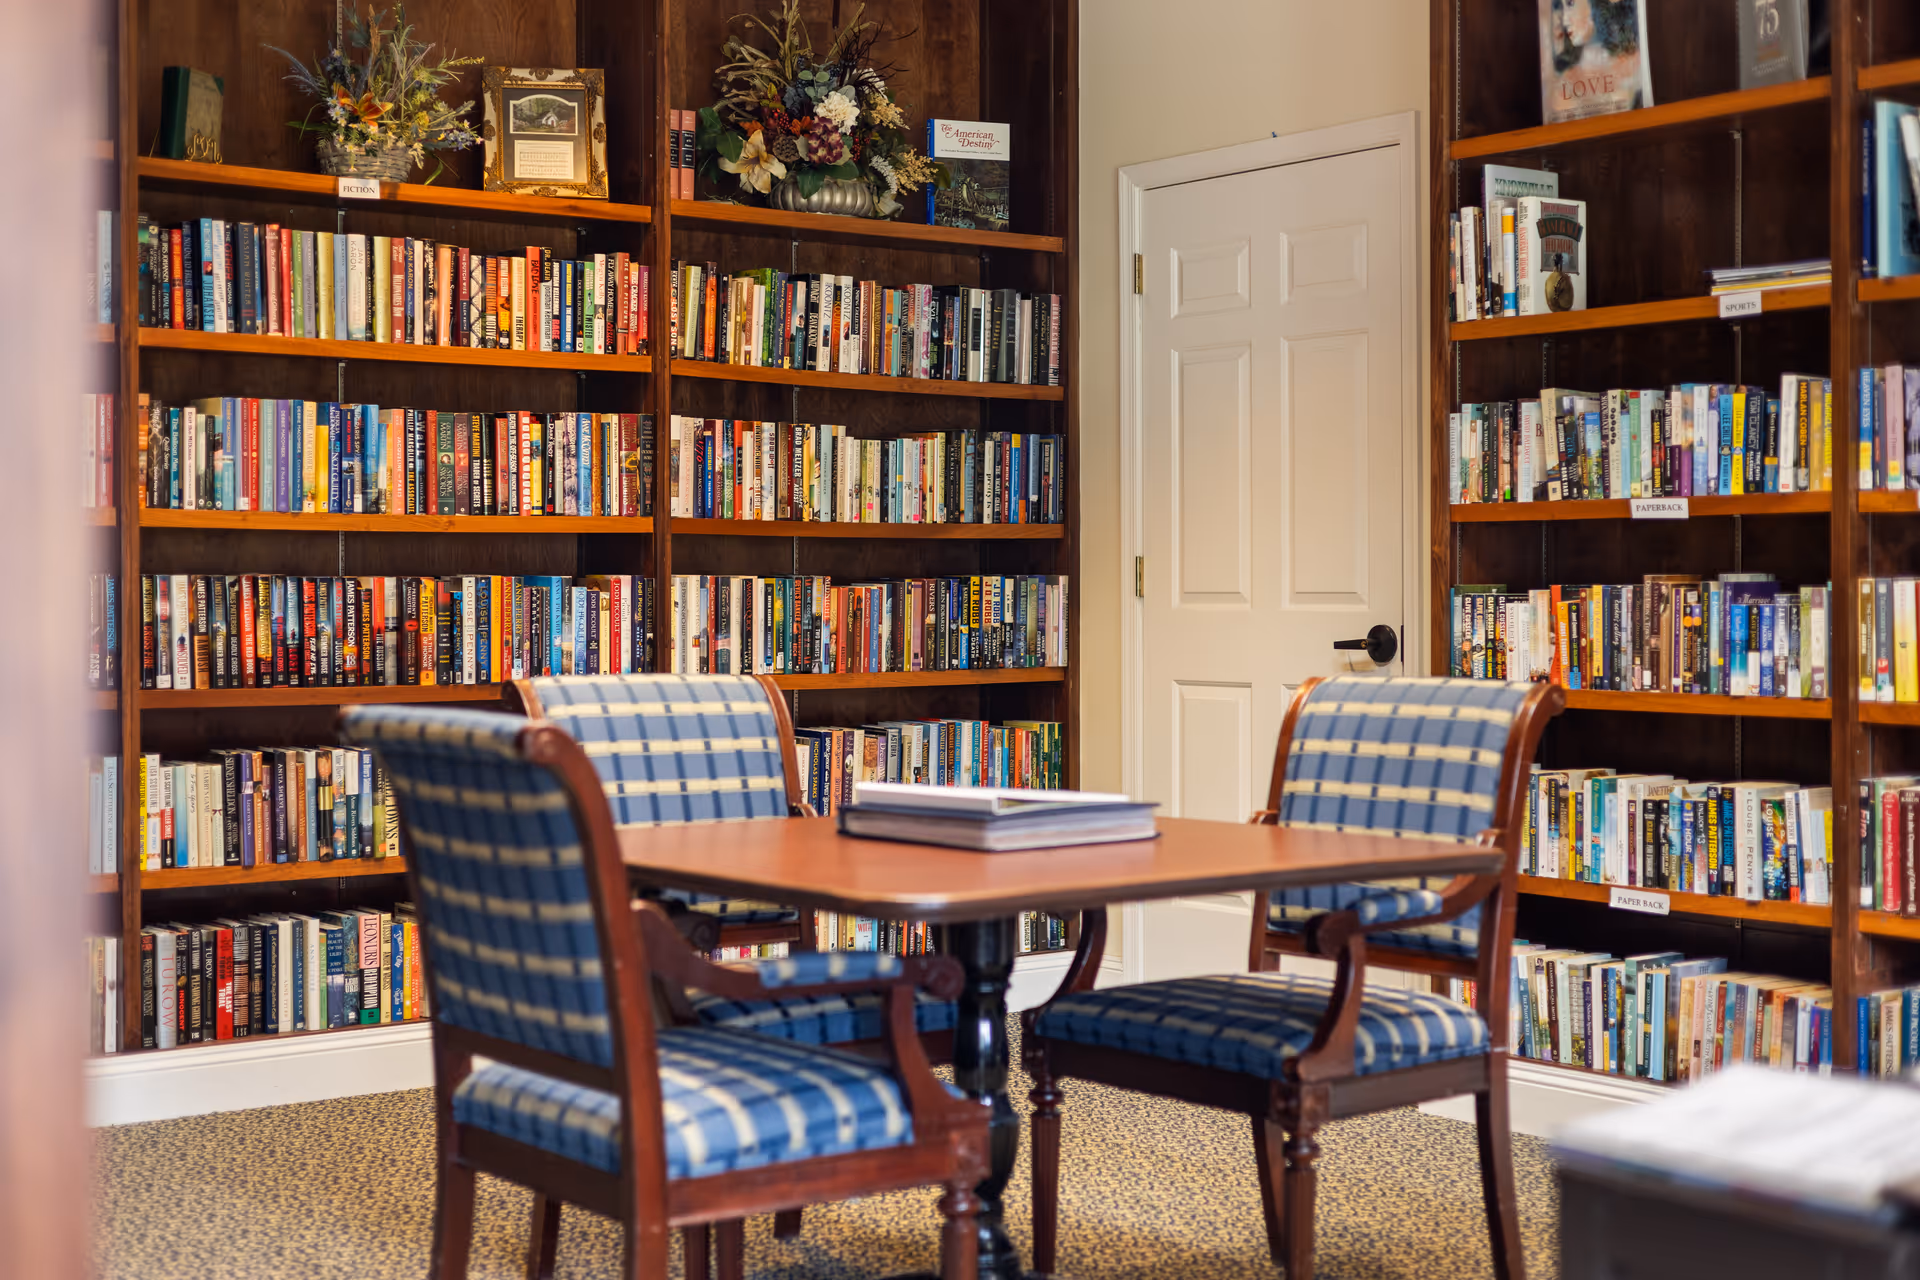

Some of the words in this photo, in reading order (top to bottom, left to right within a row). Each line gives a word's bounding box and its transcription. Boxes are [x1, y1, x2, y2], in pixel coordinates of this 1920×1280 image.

[1562, 75, 1614, 101] LOVE
[941, 124, 953, 134] The
[945, 129, 995, 142] American
[959, 138, 1000, 150] Destiny
[343, 185, 377, 194] FICTION
[843, 286, 851, 320] KOONTZ
[1725, 301, 1757, 313] SPORTS
[486, 315, 497, 339] MOTIVE
[515, 316, 524, 343] THERAPY
[585, 314, 593, 338] TWISTED
[1862, 371, 1871, 405] HEAVEN
[1749, 396, 1757, 413] TOM
[1862, 407, 1871, 429] EYES
[1748, 416, 1757, 449] CLANCY
[483, 458, 492, 477] STEVE
[483, 479, 492, 506] MARTINI
[1636, 503, 1684, 512] PAPERBACK
[197, 579, 206, 599] JAMES
[347, 580, 355, 604] JAMES
[504, 580, 512, 604] ANNE
[198, 600, 206, 633] PATTERSON
[362, 602, 370, 622] JAMES
[421, 596, 429, 633] PATTERSON
[504, 606, 512, 633] PERRY
[515, 608, 523, 635] PERRY
[744, 609, 752, 632] QUICK
[144, 625, 152, 650] CROSS
[347, 605, 355, 647] PATTERSON
[362, 623, 370, 660] PATTERSON
[376, 633, 384, 644] THE
[144, 652, 152, 669] FIRE
[197, 639, 208, 673] AMBUSH
[376, 645, 384, 671] RUSSIAN
[1708, 799, 1717, 824] JAMES
[1723, 800, 1733, 824] JAMES
[1697, 833, 1705, 844] 13
[1708, 826, 1717, 869] PATTERSON
[1723, 826, 1734, 865] PATTERSON
[1767, 854, 1775, 886] PENNY
[1617, 896, 1641, 907] PAPER
[1643, 900, 1664, 910] BACK
[364, 918, 378, 943] LEON
[364, 944, 378, 966] URIS
[162, 953, 174, 1029] TUROW
[364, 968, 378, 1009] REDEMPTION
